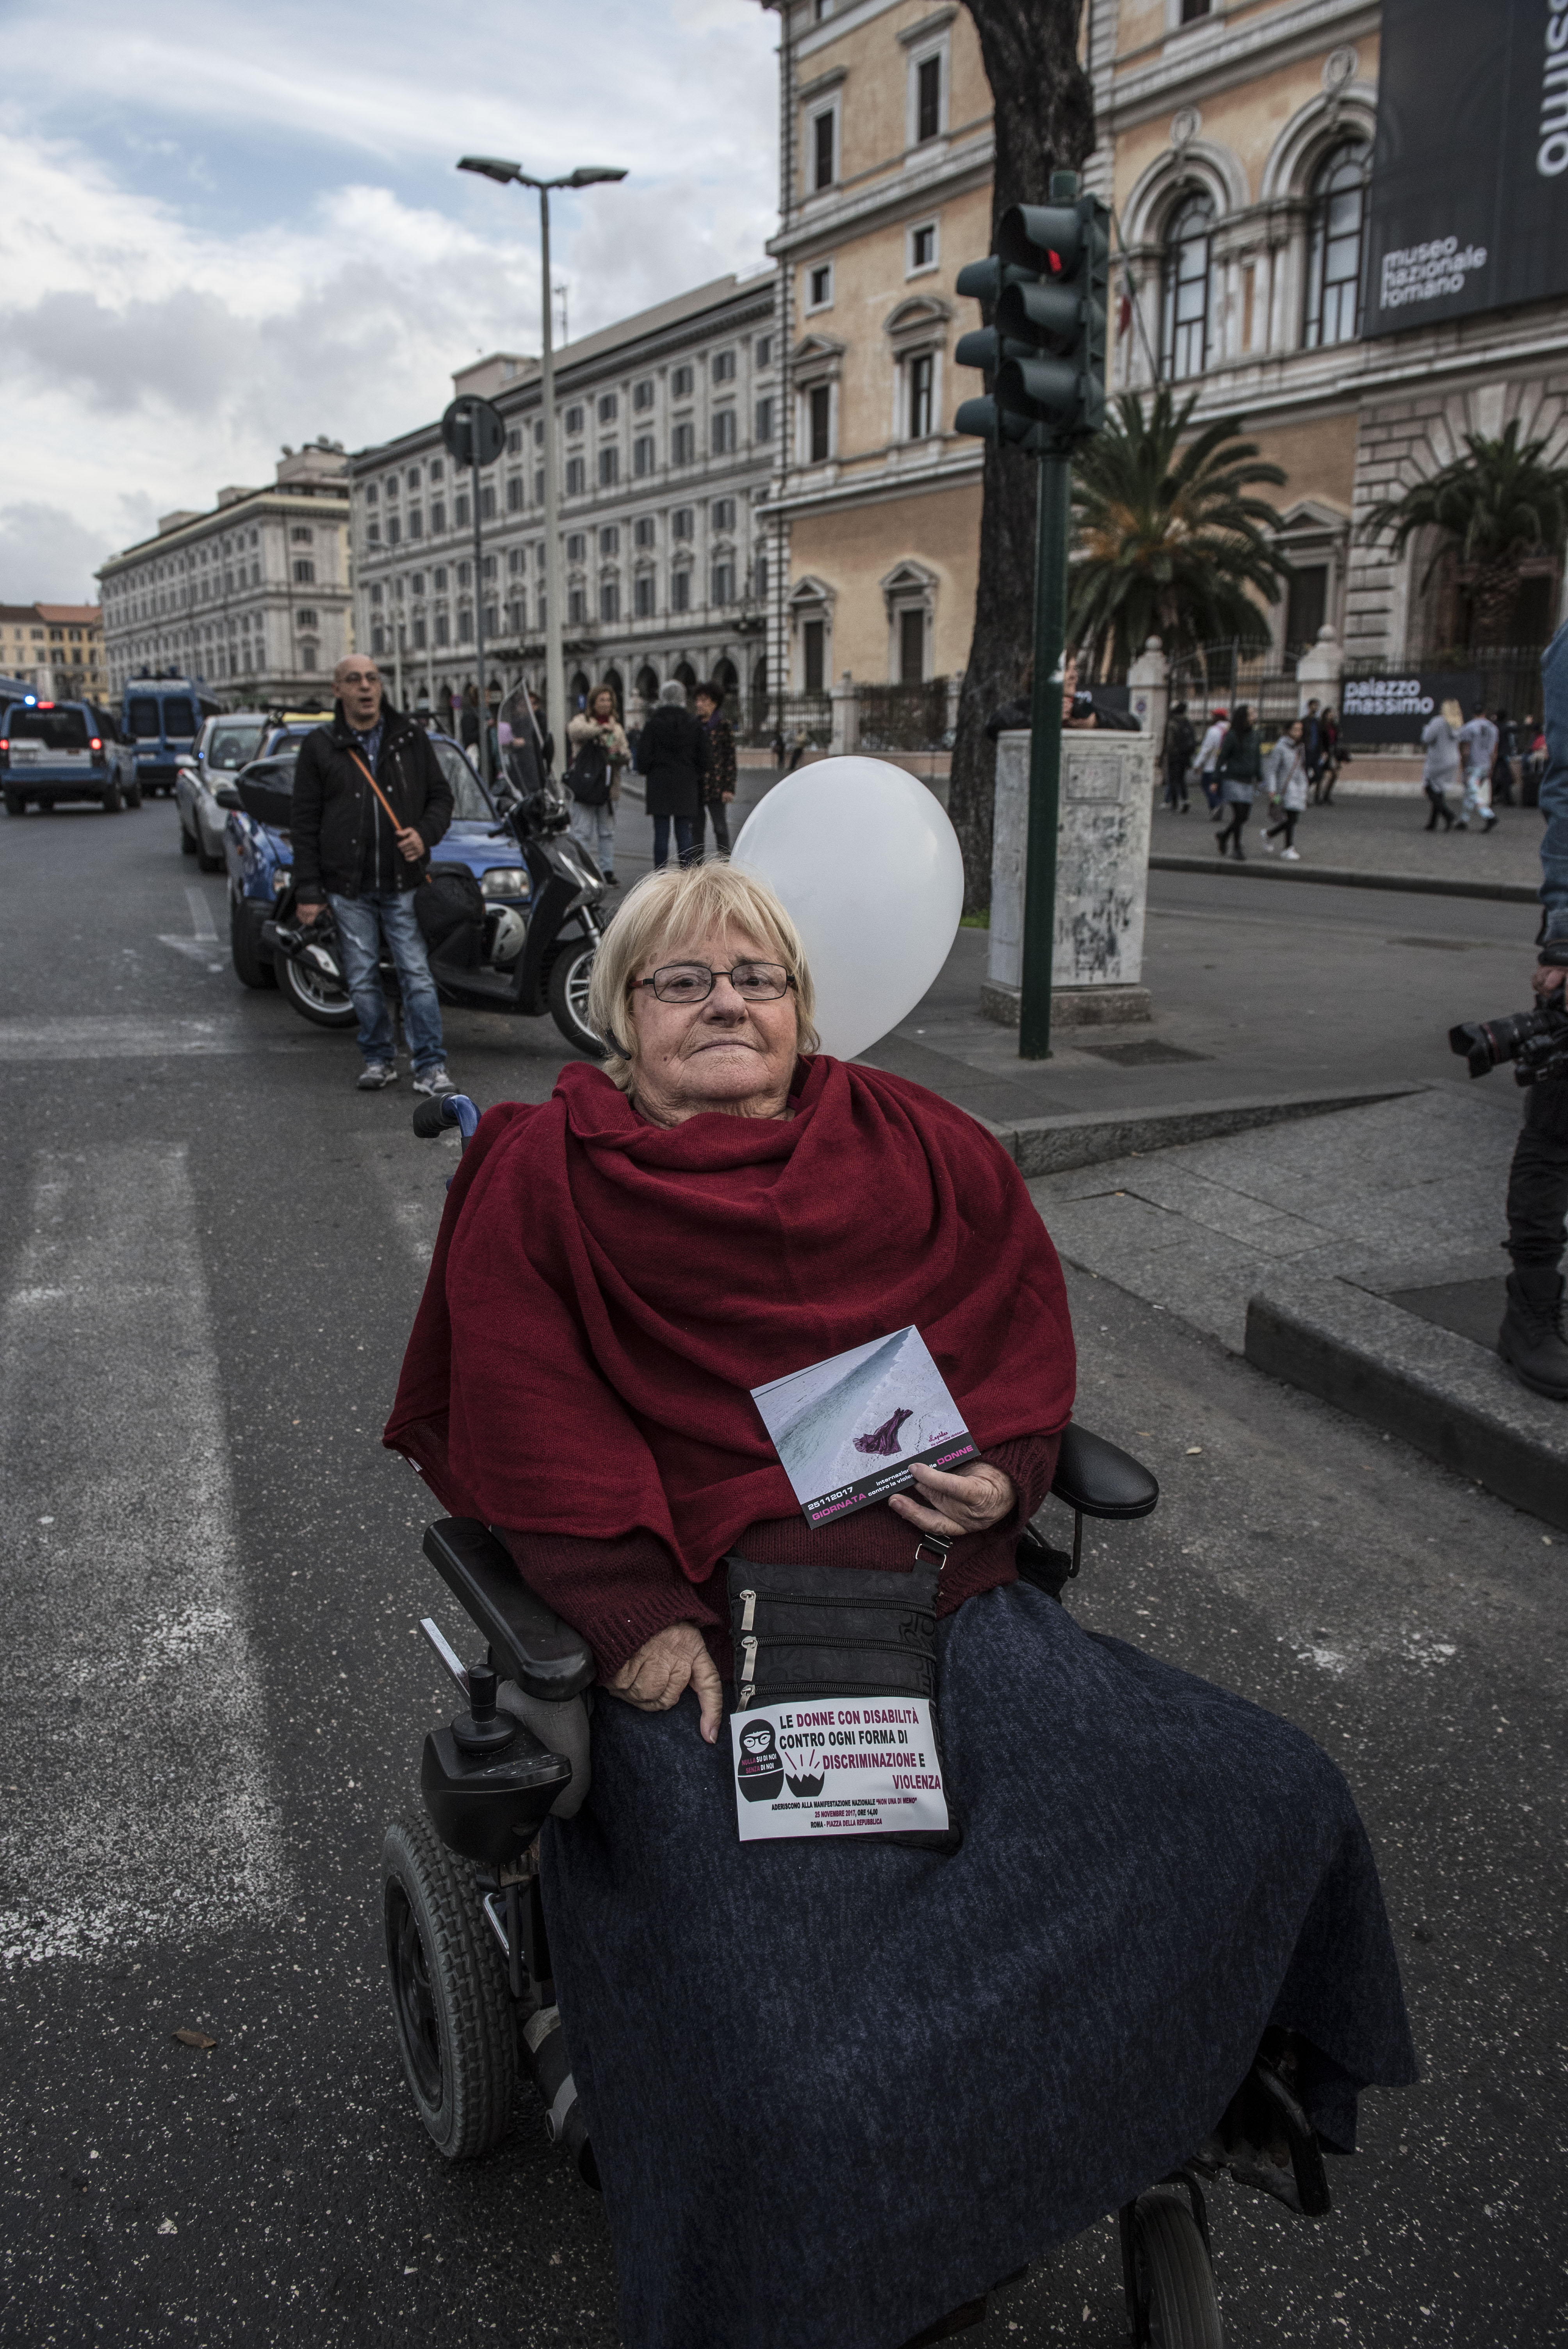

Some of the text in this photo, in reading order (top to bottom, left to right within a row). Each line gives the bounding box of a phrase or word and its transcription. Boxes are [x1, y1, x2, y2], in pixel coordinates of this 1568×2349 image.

[1382, 235, 1458, 271] museo
[1381, 244, 1487, 289] nazionale
[1379, 273, 1465, 310] romano
[1344, 676, 1421, 699] palazzo
[1343, 697, 1434, 715] massimo
[936, 1436, 951, 1444] patrizia
[951, 1429, 964, 1438] dottori
[812, 1493, 867, 1520] GIORNATA
[868, 1485, 889, 1496] contro
[936, 1445, 974, 1465] DONNE
[807, 1486, 853, 1510] 25112017
[779, 1707, 919, 1729] LE DONNE CON DISABILITÀ
[779, 1730, 908, 1750] CONTRO OGNI FORMA DI
[742, 1757, 756, 1766] NULLA
[746, 1766, 760, 1774] SENZA
[823, 1752, 926, 1770] DISCRIMINAZIONE E
[892, 1775, 941, 1789] VIOLENZA
[772, 1802, 800, 1811] ADERISCONO
